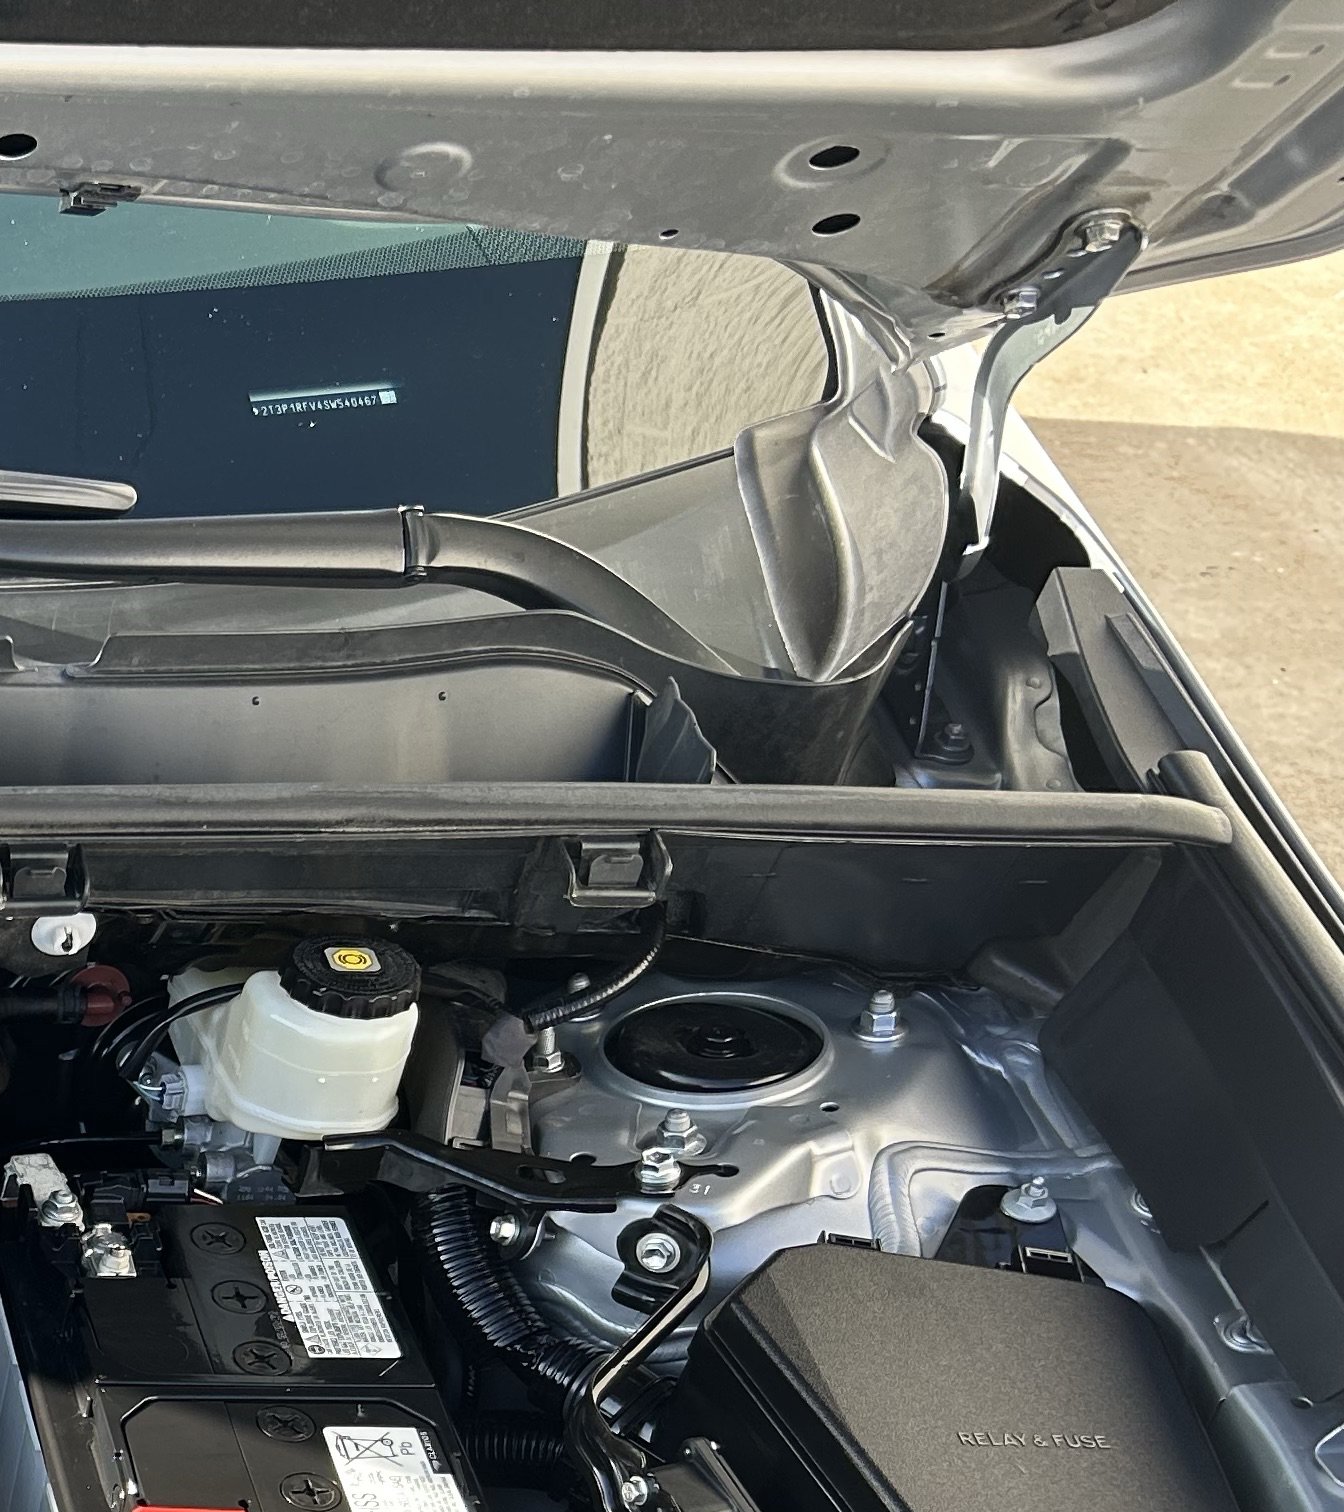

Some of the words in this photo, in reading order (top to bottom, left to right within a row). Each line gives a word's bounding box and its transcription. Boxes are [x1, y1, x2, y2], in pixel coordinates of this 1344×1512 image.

[261, 395, 377, 416] 2T3P1RFV4SW540467
[957, 1431, 1026, 1447] RELAY
[1033, 1433, 1048, 1447] &
[1052, 1434, 1111, 1448] FUSE
[400, 1441, 416, 1456] Pb
